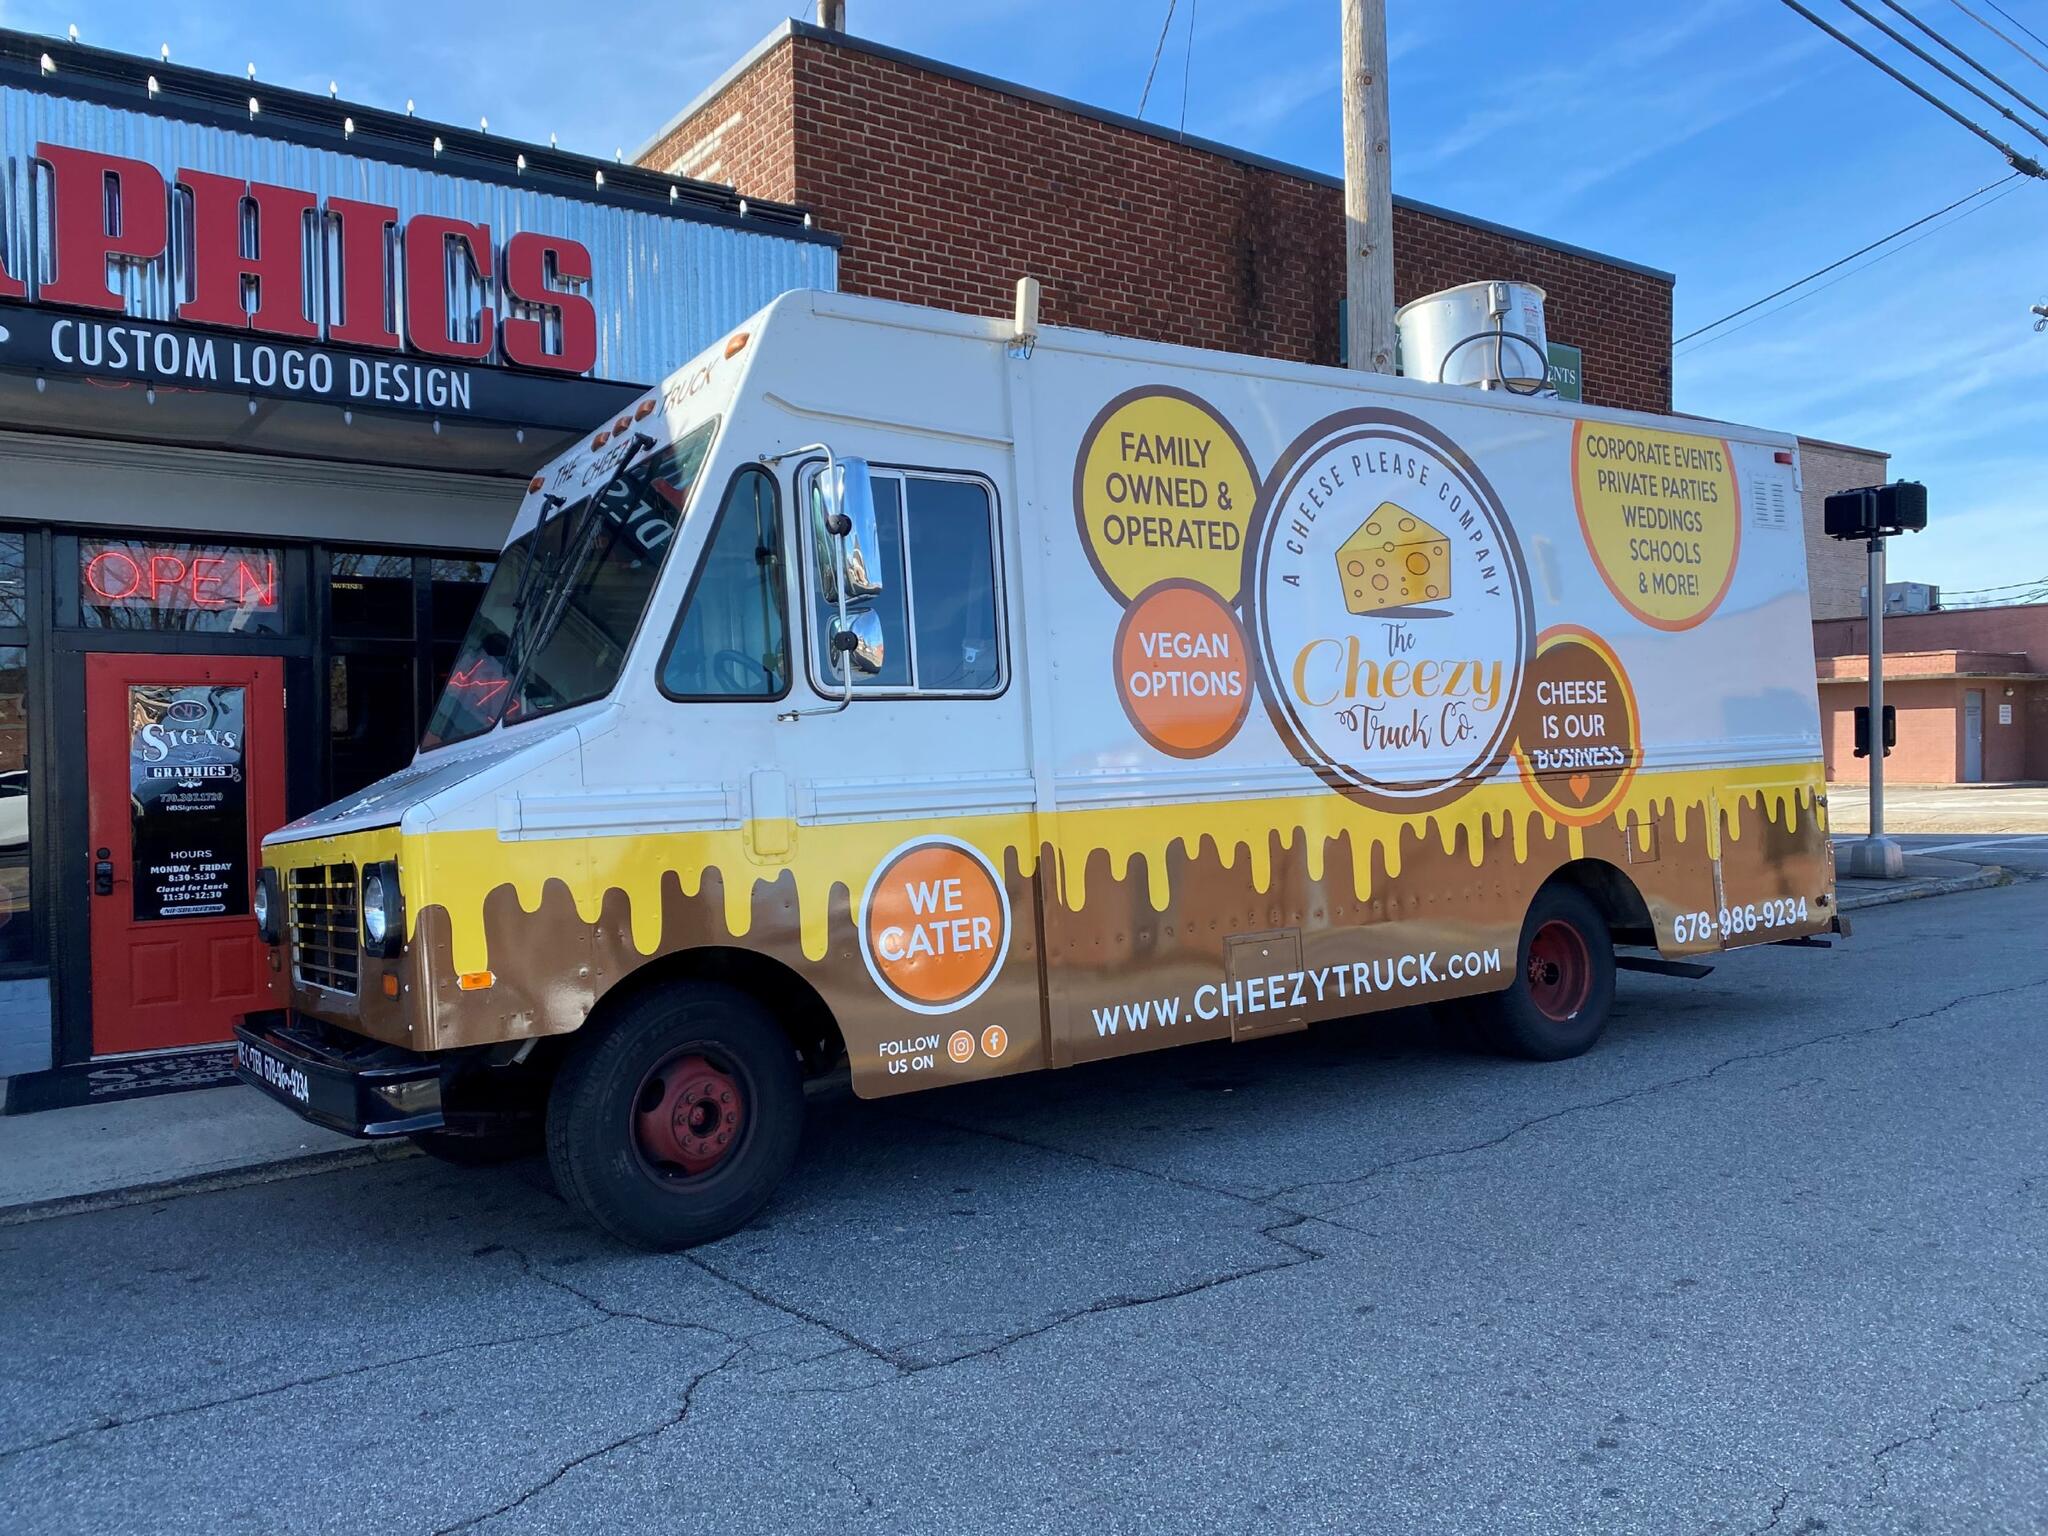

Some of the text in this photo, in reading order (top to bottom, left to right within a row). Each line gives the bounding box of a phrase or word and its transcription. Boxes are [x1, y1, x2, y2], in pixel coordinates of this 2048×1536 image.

[0, 142, 597, 373] PHICS
[50, 319, 471, 409] CUSTOM LOGO DESIGN
[552, 356, 720, 489] THE CHEEZ TRUCK
[1119, 431, 1212, 469] FAMILY
[1586, 434, 1723, 473] CORPORATE EVENTS
[1105, 472, 1233, 511] OWNED &
[1598, 469, 1718, 503] PRIVATE PARTIES
[1102, 514, 1240, 551] OPERATED
[1282, 451, 1500, 597] A CHEESE PLEASE COMPANY
[1622, 504, 1703, 533] WEDDINGS
[1629, 538, 1702, 564] SCHOOLS
[86, 552, 274, 606] OPEN
[1638, 571, 1700, 596] & MORE!
[1138, 632, 1229, 659] VEGAN
[1381, 621, 1416, 657] The
[1129, 670, 1243, 698] OPTIONS
[1292, 634, 1503, 711] Cheezy
[1536, 680, 1608, 706] CHEESE
[1334, 701, 1478, 750] Truck Co.
[1542, 714, 1606, 739] IS OUR
[153, 765, 226, 778] GRAPHICS
[1533, 745, 1625, 769] BUSINESS
[150, 864, 191, 874] MONDAY
[199, 862, 232, 872] FRIDAY
[170, 849, 213, 860] HOURS
[156, 882, 229, 893] Closed for Lunch
[168, 872, 217, 882] 8:30-5:30
[162, 891, 222, 902] 11:30-12:30
[905, 878, 963, 915] WE
[1674, 896, 1808, 944] 678-986-9234
[878, 917, 994, 962] CATER
[1091, 948, 1501, 1037] WWW.CHEEZYTRUCK.COM
[878, 1034, 940, 1057] FOLLOW
[888, 1055, 934, 1075] US ON
